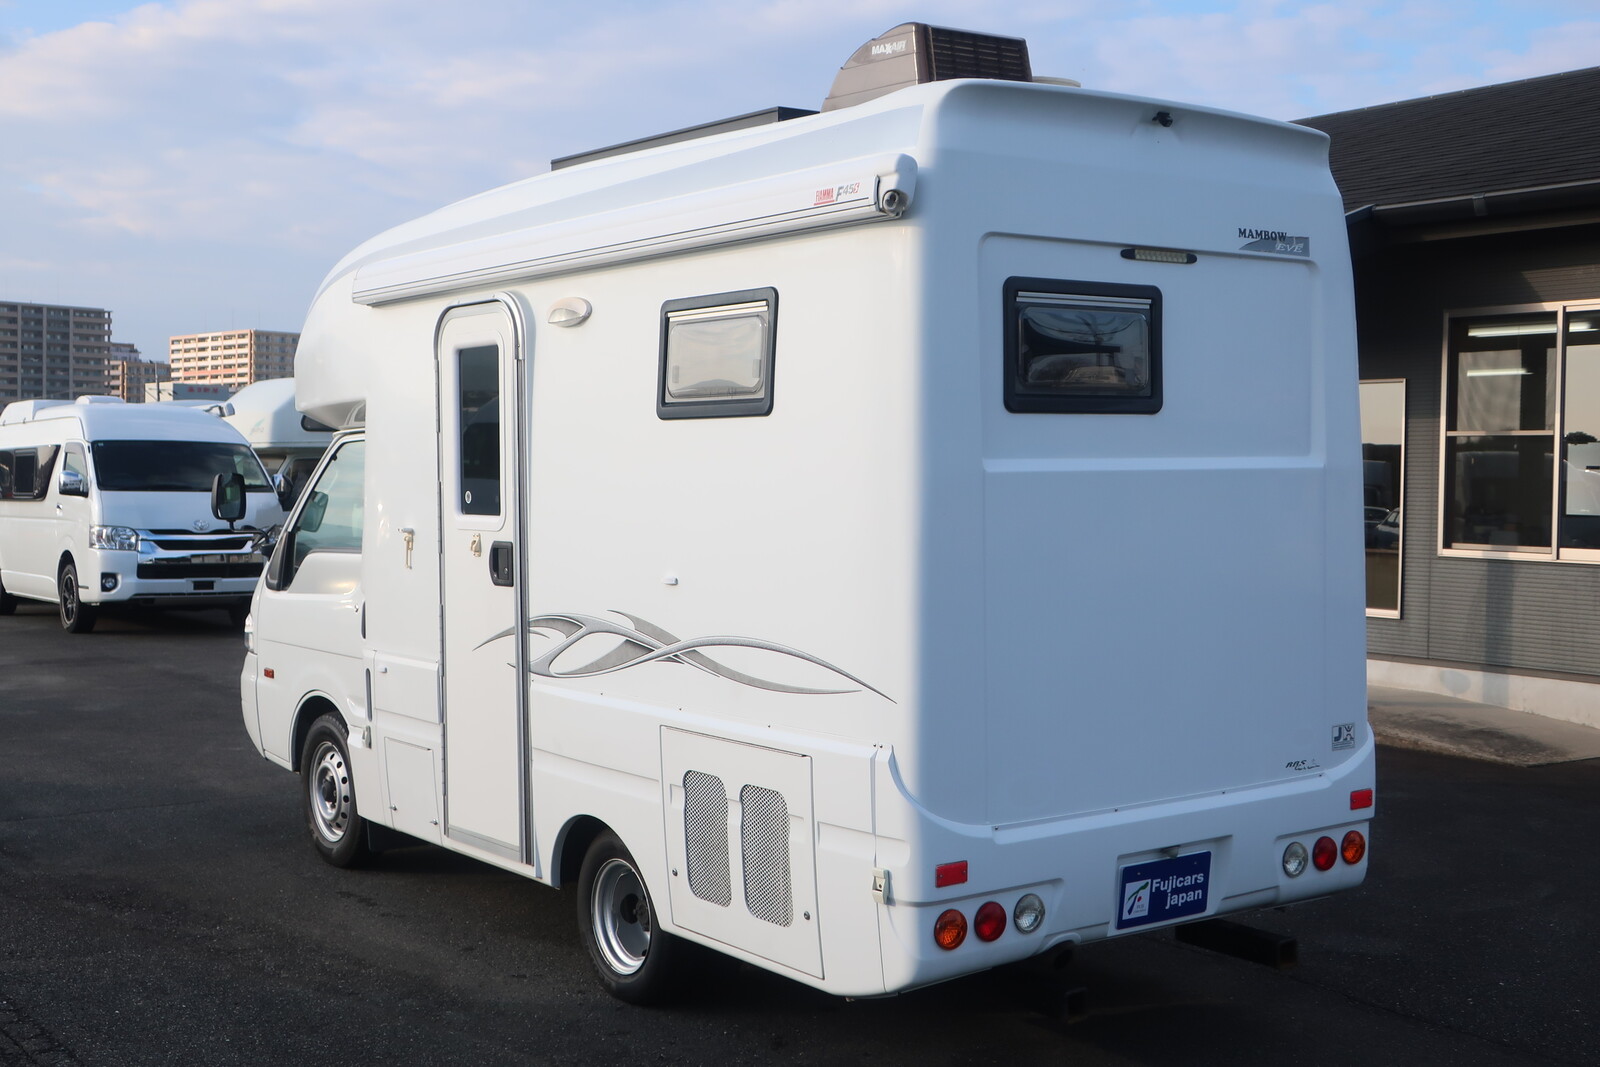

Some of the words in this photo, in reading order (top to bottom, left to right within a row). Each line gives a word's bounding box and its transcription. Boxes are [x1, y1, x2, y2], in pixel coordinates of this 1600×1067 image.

[1238, 228, 1287, 242] MAMBOW
[1276, 243, 1304, 253] EVE
[1151, 873, 1205, 893] Fujicars
[1165, 889, 1203, 910] japan
